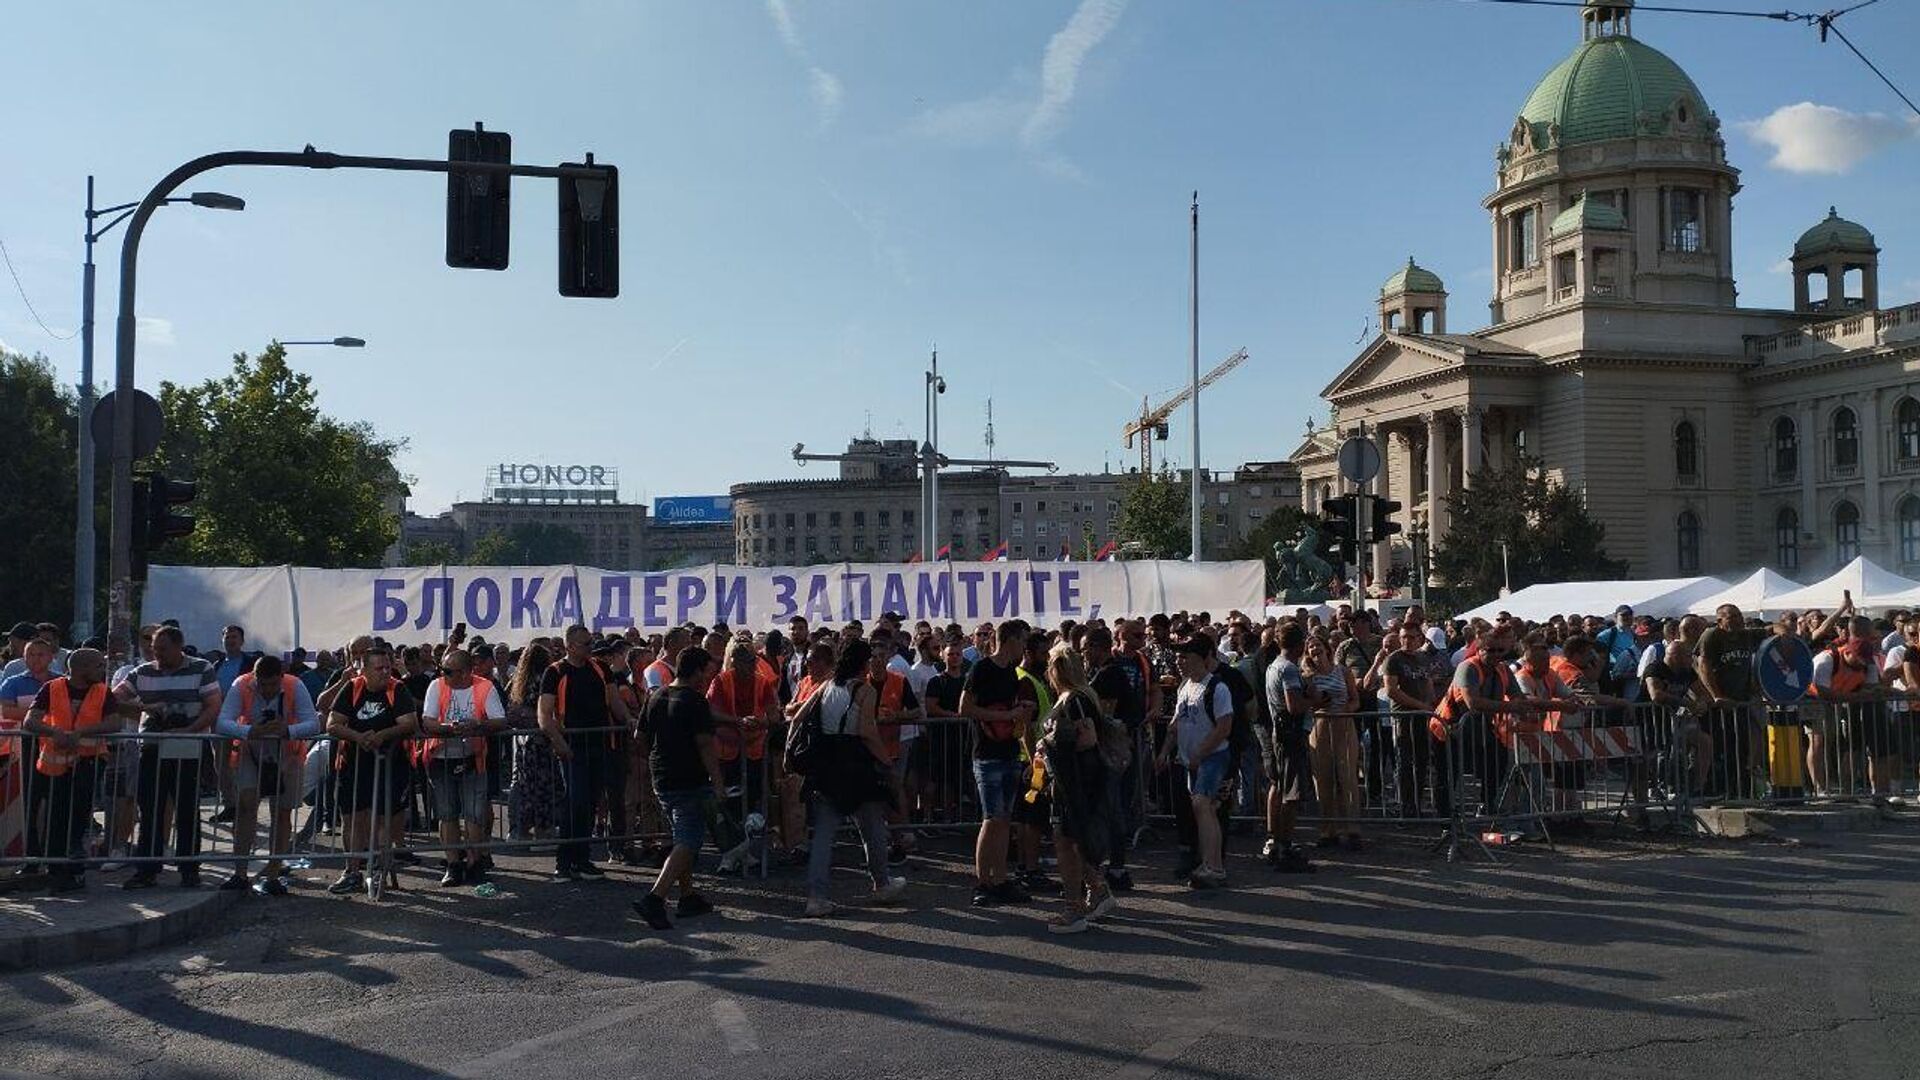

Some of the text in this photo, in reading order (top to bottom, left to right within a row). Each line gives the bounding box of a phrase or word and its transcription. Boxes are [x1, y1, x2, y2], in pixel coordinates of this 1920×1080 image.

[500, 464, 606, 485] HONOR
[665, 504, 705, 518] Midea
[373, 570, 1101, 632] БЛОКАДЕРИ ЗАПАМТИТЕ,
